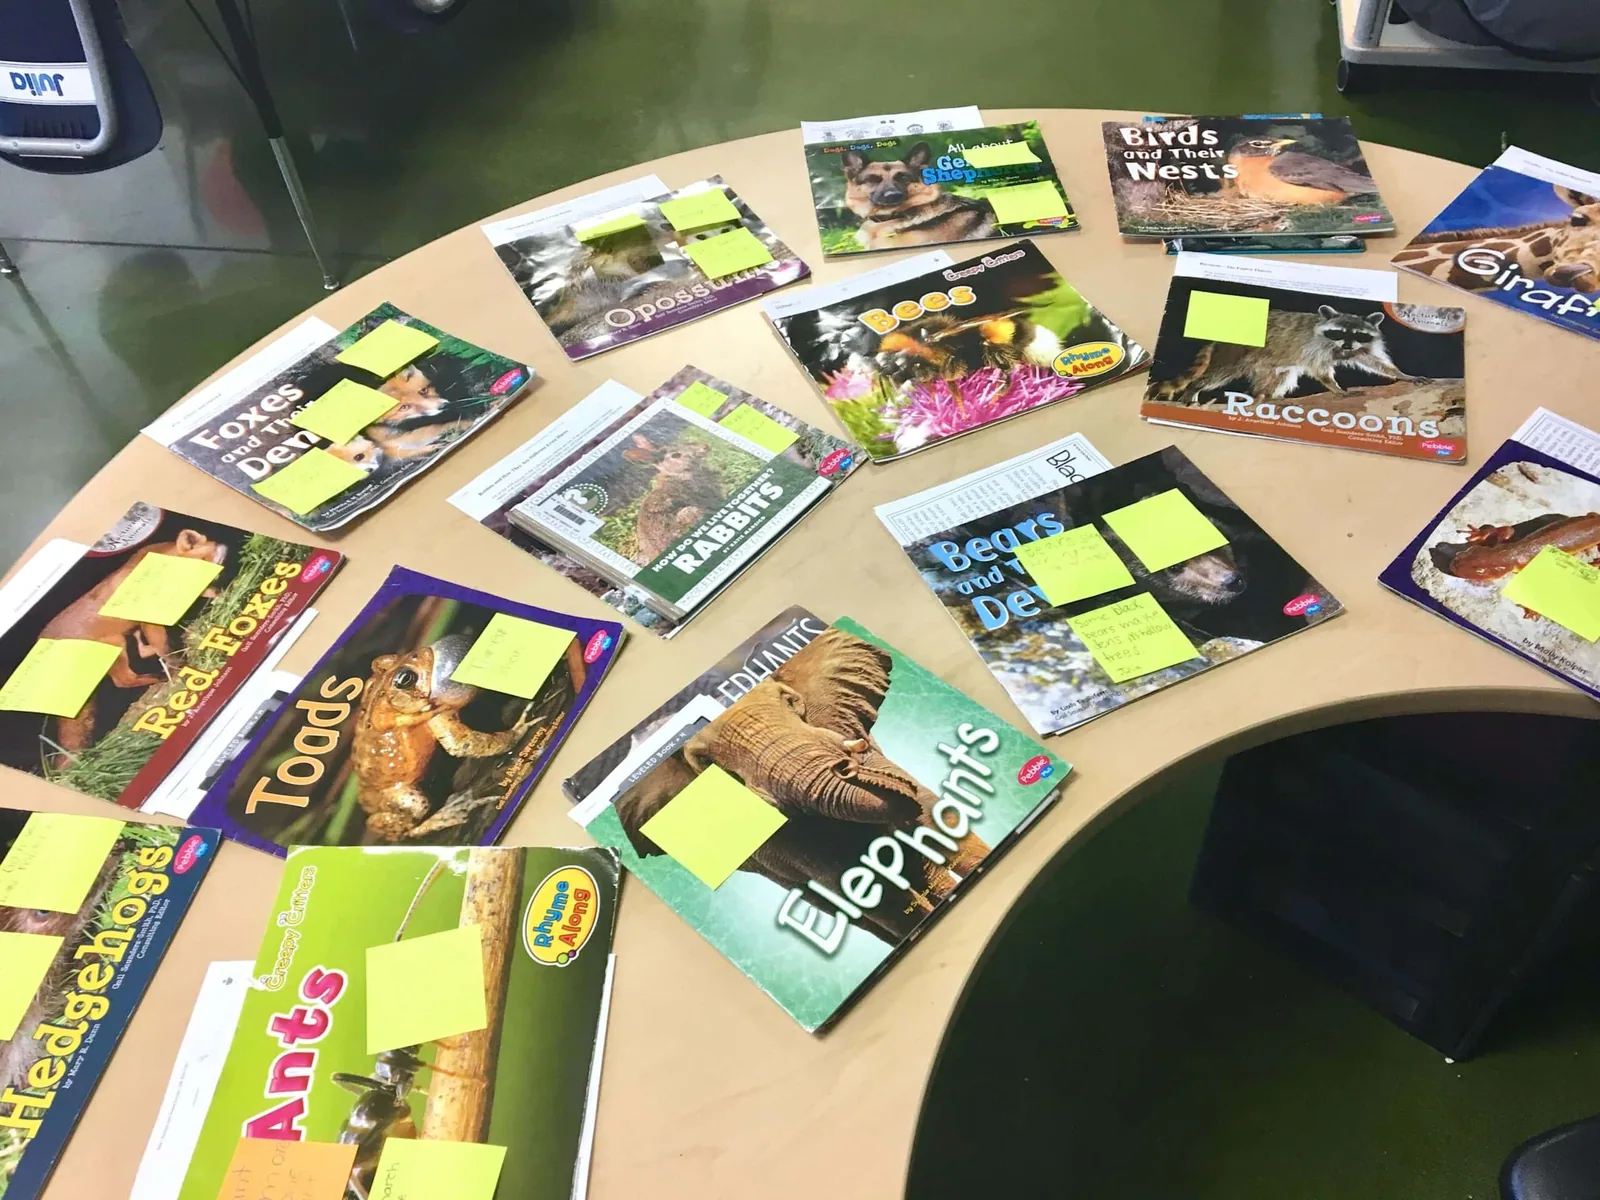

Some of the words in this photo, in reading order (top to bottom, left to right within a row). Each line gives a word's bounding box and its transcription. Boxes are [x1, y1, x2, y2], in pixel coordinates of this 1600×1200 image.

[9, 72, 64, 96] Julia
[947, 143, 965, 154] All
[1119, 125, 1219, 147] Birds
[1124, 150, 1162, 160] and
[1172, 149, 1225, 160] Their
[1125, 162, 1239, 182] Nests
[942, 263, 985, 282] Creepy
[1458, 248, 1600, 317] Giraf
[857, 285, 977, 335] Bees
[1400, 310, 1452, 321] Nocturnal
[1409, 316, 1448, 327] Animals
[1059, 345, 1110, 366] Rhyme
[1072, 355, 1114, 376] Along
[188, 383, 304, 451] Foxes
[1222, 391, 1440, 438] Raccoons
[221, 435, 262, 464] and
[236, 430, 322, 481] Den
[821, 450, 848, 474] Pebble
[1421, 441, 1453, 450] Pebble
[108, 510, 144, 550] Nocturnal
[121, 518, 152, 547] Animals
[652, 549, 678, 572] HOW
[676, 538, 693, 551] DO
[691, 525, 709, 538] WE
[706, 507, 729, 525] LIVE
[725, 467, 775, 509] TOGETHER?
[671, 481, 784, 575] RABBITS
[928, 511, 1065, 573] Bears
[957, 567, 1004, 595] and
[198, 561, 302, 657] Foxes
[285, 592, 298, 608] Editor
[1074, 612, 1111, 629] Some
[1113, 599, 1145, 616] black
[1285, 594, 1317, 615] Pebble
[241, 642, 251, 653] Gail
[586, 632, 605, 661] Pebble
[1084, 624, 1116, 640] bears
[1094, 635, 1122, 650] dens
[1522, 637, 1534, 647] by
[1534, 643, 1559, 661] Molly
[1559, 656, 1588, 675] Kolpin
[213, 666, 233, 689] Johnson
[132, 666, 221, 740] Red
[214, 738, 240, 767] LEVELED
[238, 721, 256, 738] BOOK
[245, 674, 364, 815] Toads
[498, 776, 511, 788] by
[518, 726, 547, 758] Sweeney
[628, 755, 658, 784] LEVELED
[656, 741, 677, 759] BOOK
[1020, 756, 1050, 785] Pebble
[177, 837, 200, 872] Pebble
[778, 721, 1000, 959] Elephants
[278, 864, 317, 928] Critters
[532, 879, 569, 949] Rhyme
[903, 906, 914, 915] by
[136, 920, 160, 960] Consulting
[154, 897, 171, 921] Editor
[560, 887, 592, 947] Along
[111, 970, 126, 990] Gail
[123, 915, 154, 974] Saunders-Smith,
[264, 929, 300, 992] Creepy
[0, 845, 173, 1139] Hedgehogs
[63, 1075, 73, 1089] by
[68, 1051, 86, 1080] Mary
[84, 1022, 102, 1045] Dunn
[242, 965, 348, 1141] Ants
